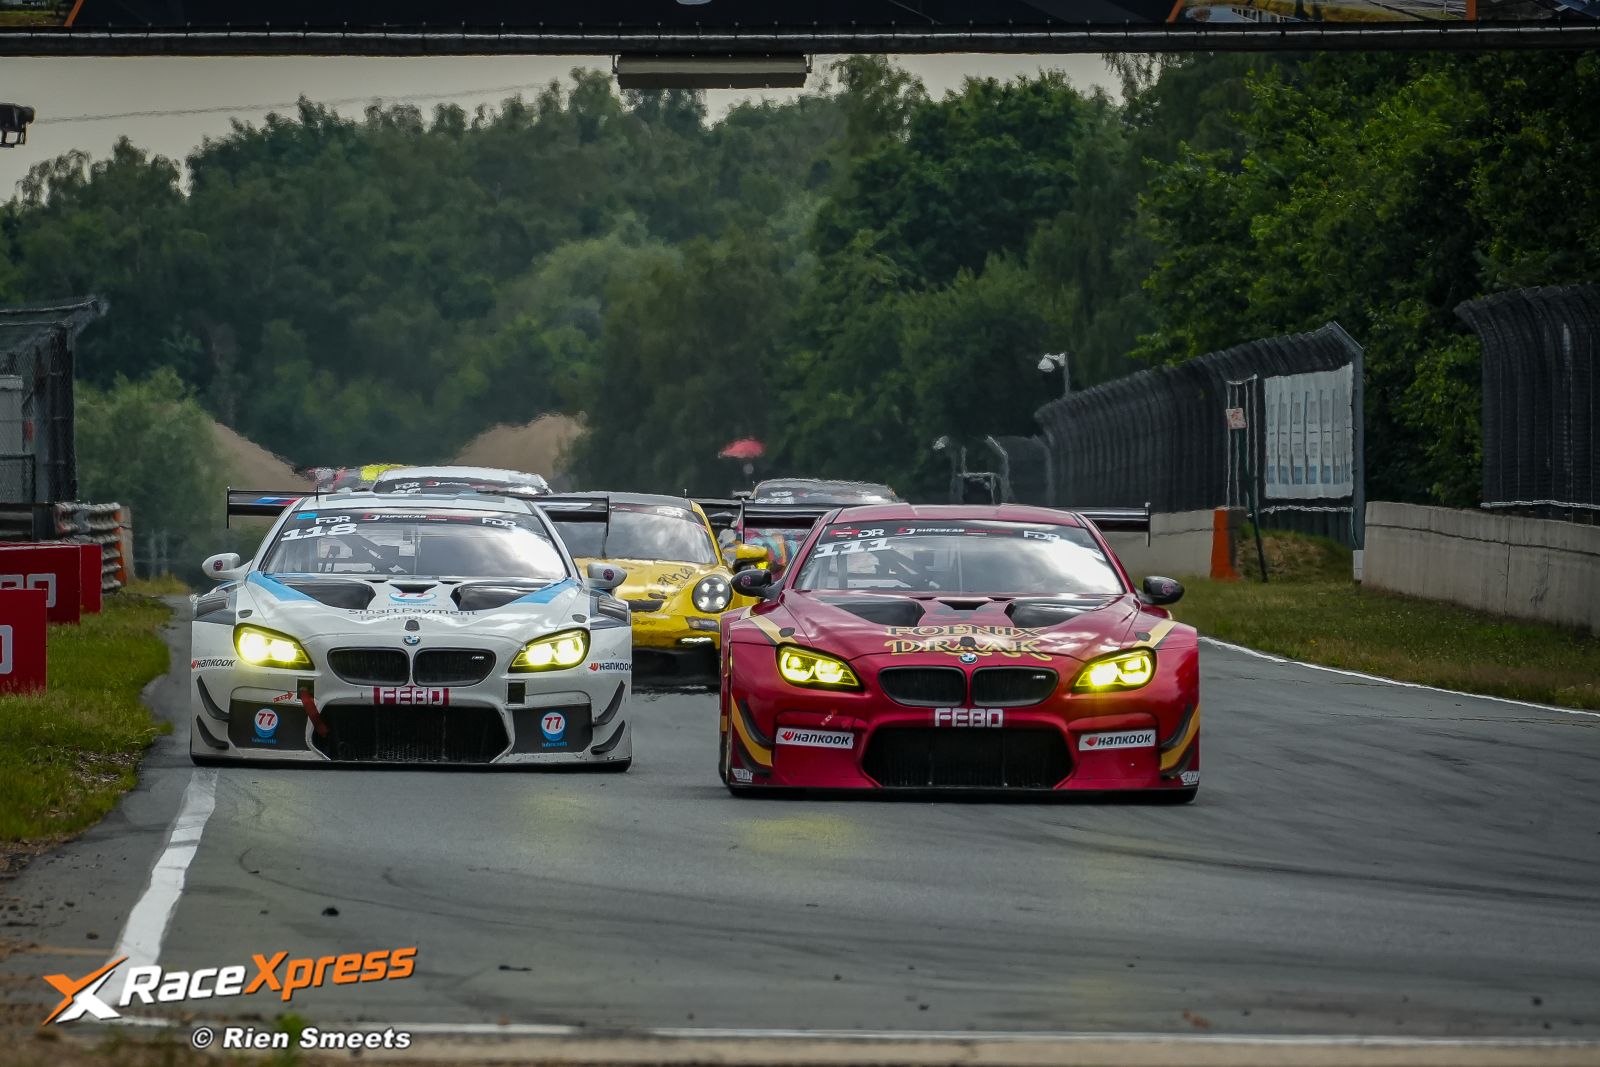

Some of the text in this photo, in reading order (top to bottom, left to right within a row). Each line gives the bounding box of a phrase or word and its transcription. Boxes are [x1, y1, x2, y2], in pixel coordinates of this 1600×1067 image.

[315, 515, 351, 524] FDR
[481, 517, 517, 528] FDR
[281, 523, 358, 541] 118
[1023, 530, 1060, 540] FDR
[814, 538, 892, 558] 111
[884, 624, 1046, 637] FOENIX
[884, 639, 1053, 661] DRAAK
[379, 686, 444, 705] FEBO
[257, 712, 276, 726] 77
[544, 716, 562, 730] 77
[934, 707, 1004, 728] FEBO
